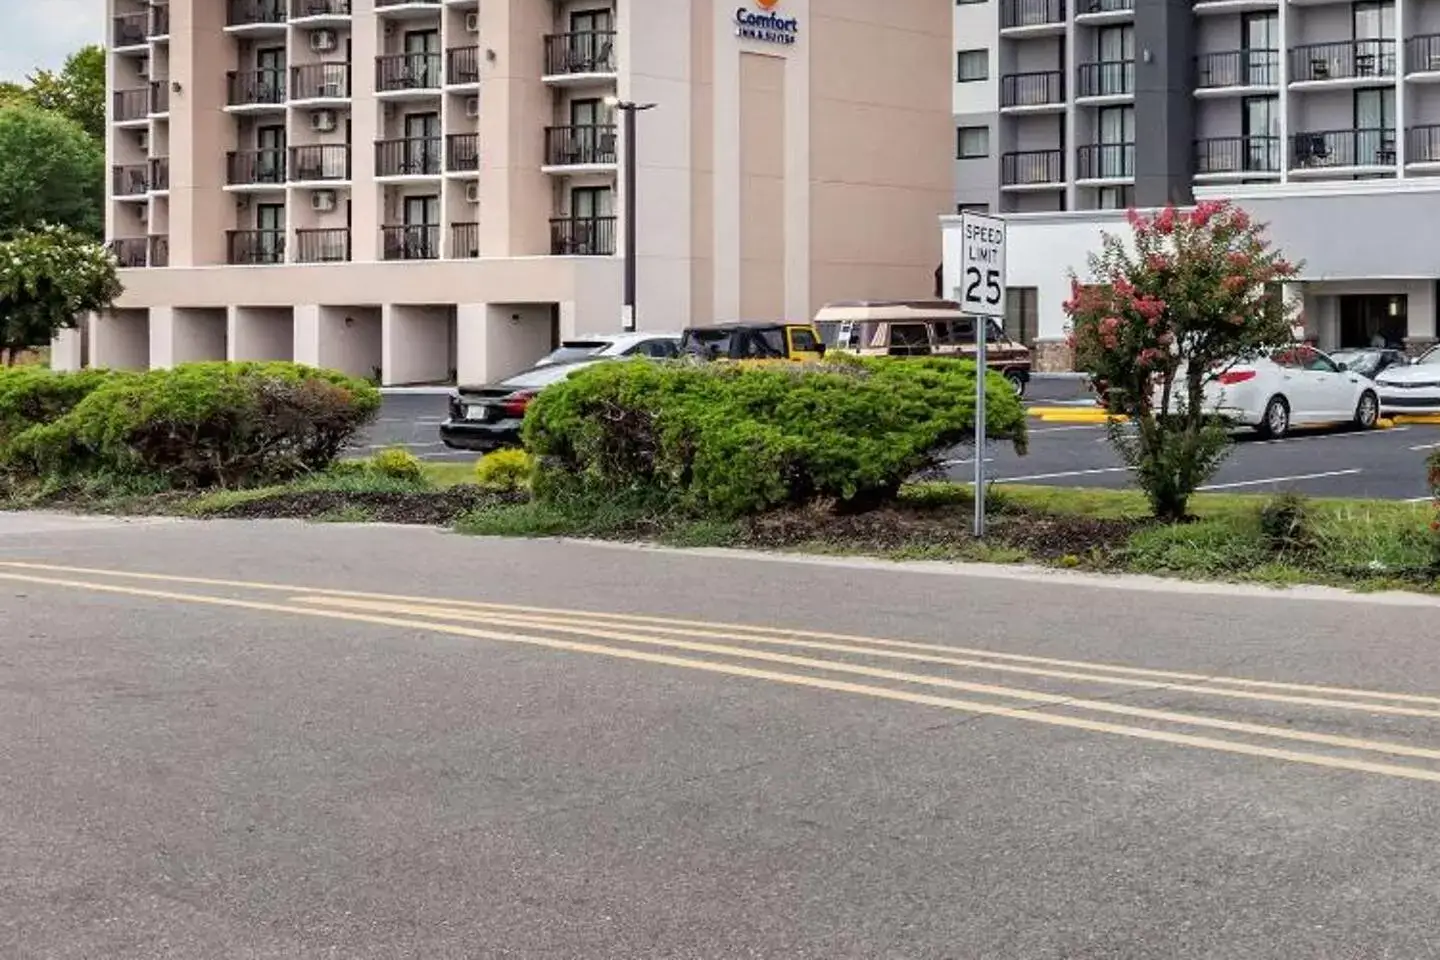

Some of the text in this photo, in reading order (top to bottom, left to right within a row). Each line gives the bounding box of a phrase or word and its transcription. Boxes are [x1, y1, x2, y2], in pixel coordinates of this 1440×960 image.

[735, 7, 798, 33] Comfort
[965, 223, 1003, 245] SPEED
[968, 245, 999, 264] LIMIT
[965, 266, 1002, 305] 25
